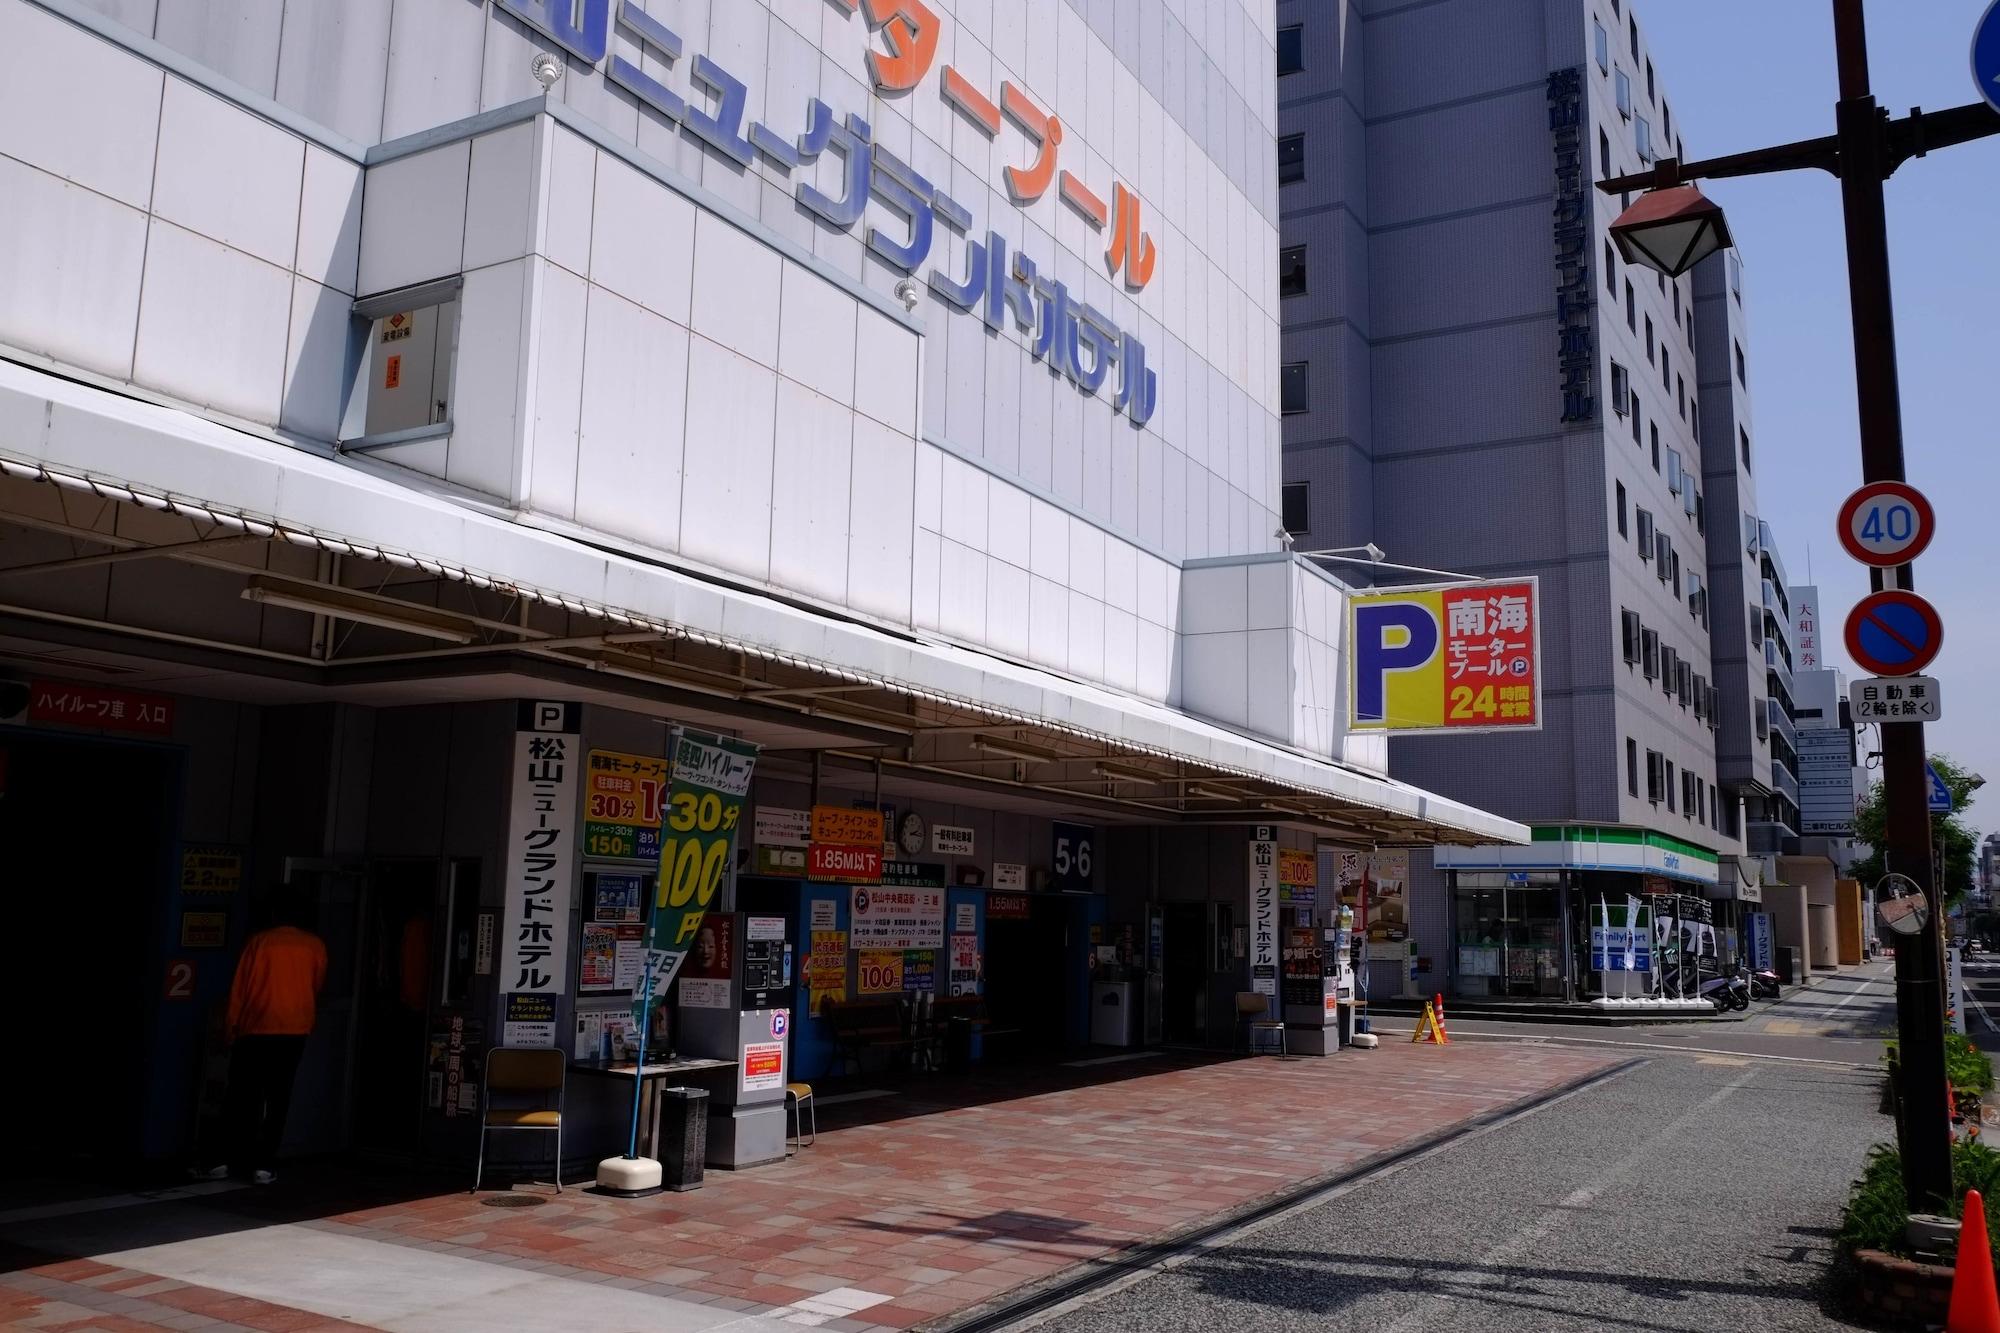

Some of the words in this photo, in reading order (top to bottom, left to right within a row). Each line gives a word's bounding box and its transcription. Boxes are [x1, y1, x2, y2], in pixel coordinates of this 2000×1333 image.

[826, 0, 1156, 290] タープール
[1861, 505, 1913, 543] 40
[1447, 595, 1529, 637] 南海
[1448, 637, 1527, 659] モーター
[1354, 600, 1441, 724] P
[1448, 659, 1508, 680] プール
[1449, 685, 1498, 719] 24
[1499, 686, 1530, 700] 時間
[1863, 685, 1926, 700] 自動車
[37, 691, 127, 720] ハイルーフ車
[135, 702, 167, 724] 入口
[540, 706, 561, 727] P
[1499, 701, 1531, 718] 営業
[1856, 701, 1935, 717] (2輪を除く)
[590, 793, 637, 819] 30分
[669, 792, 741, 833] 30分
[1259, 828, 1268, 838] P
[515, 737, 567, 990] 松山ニューグランドホテル
[814, 847, 878, 873] 1.85M以下
[655, 838, 729, 909] 100
[858, 896, 867, 908] P
[1255, 843, 1272, 964] 松山ニューグランドホテル
[1594, 930, 1647, 944] Failyart
[168, 963, 194, 998] 2
[774, 1016, 785, 1033] P
